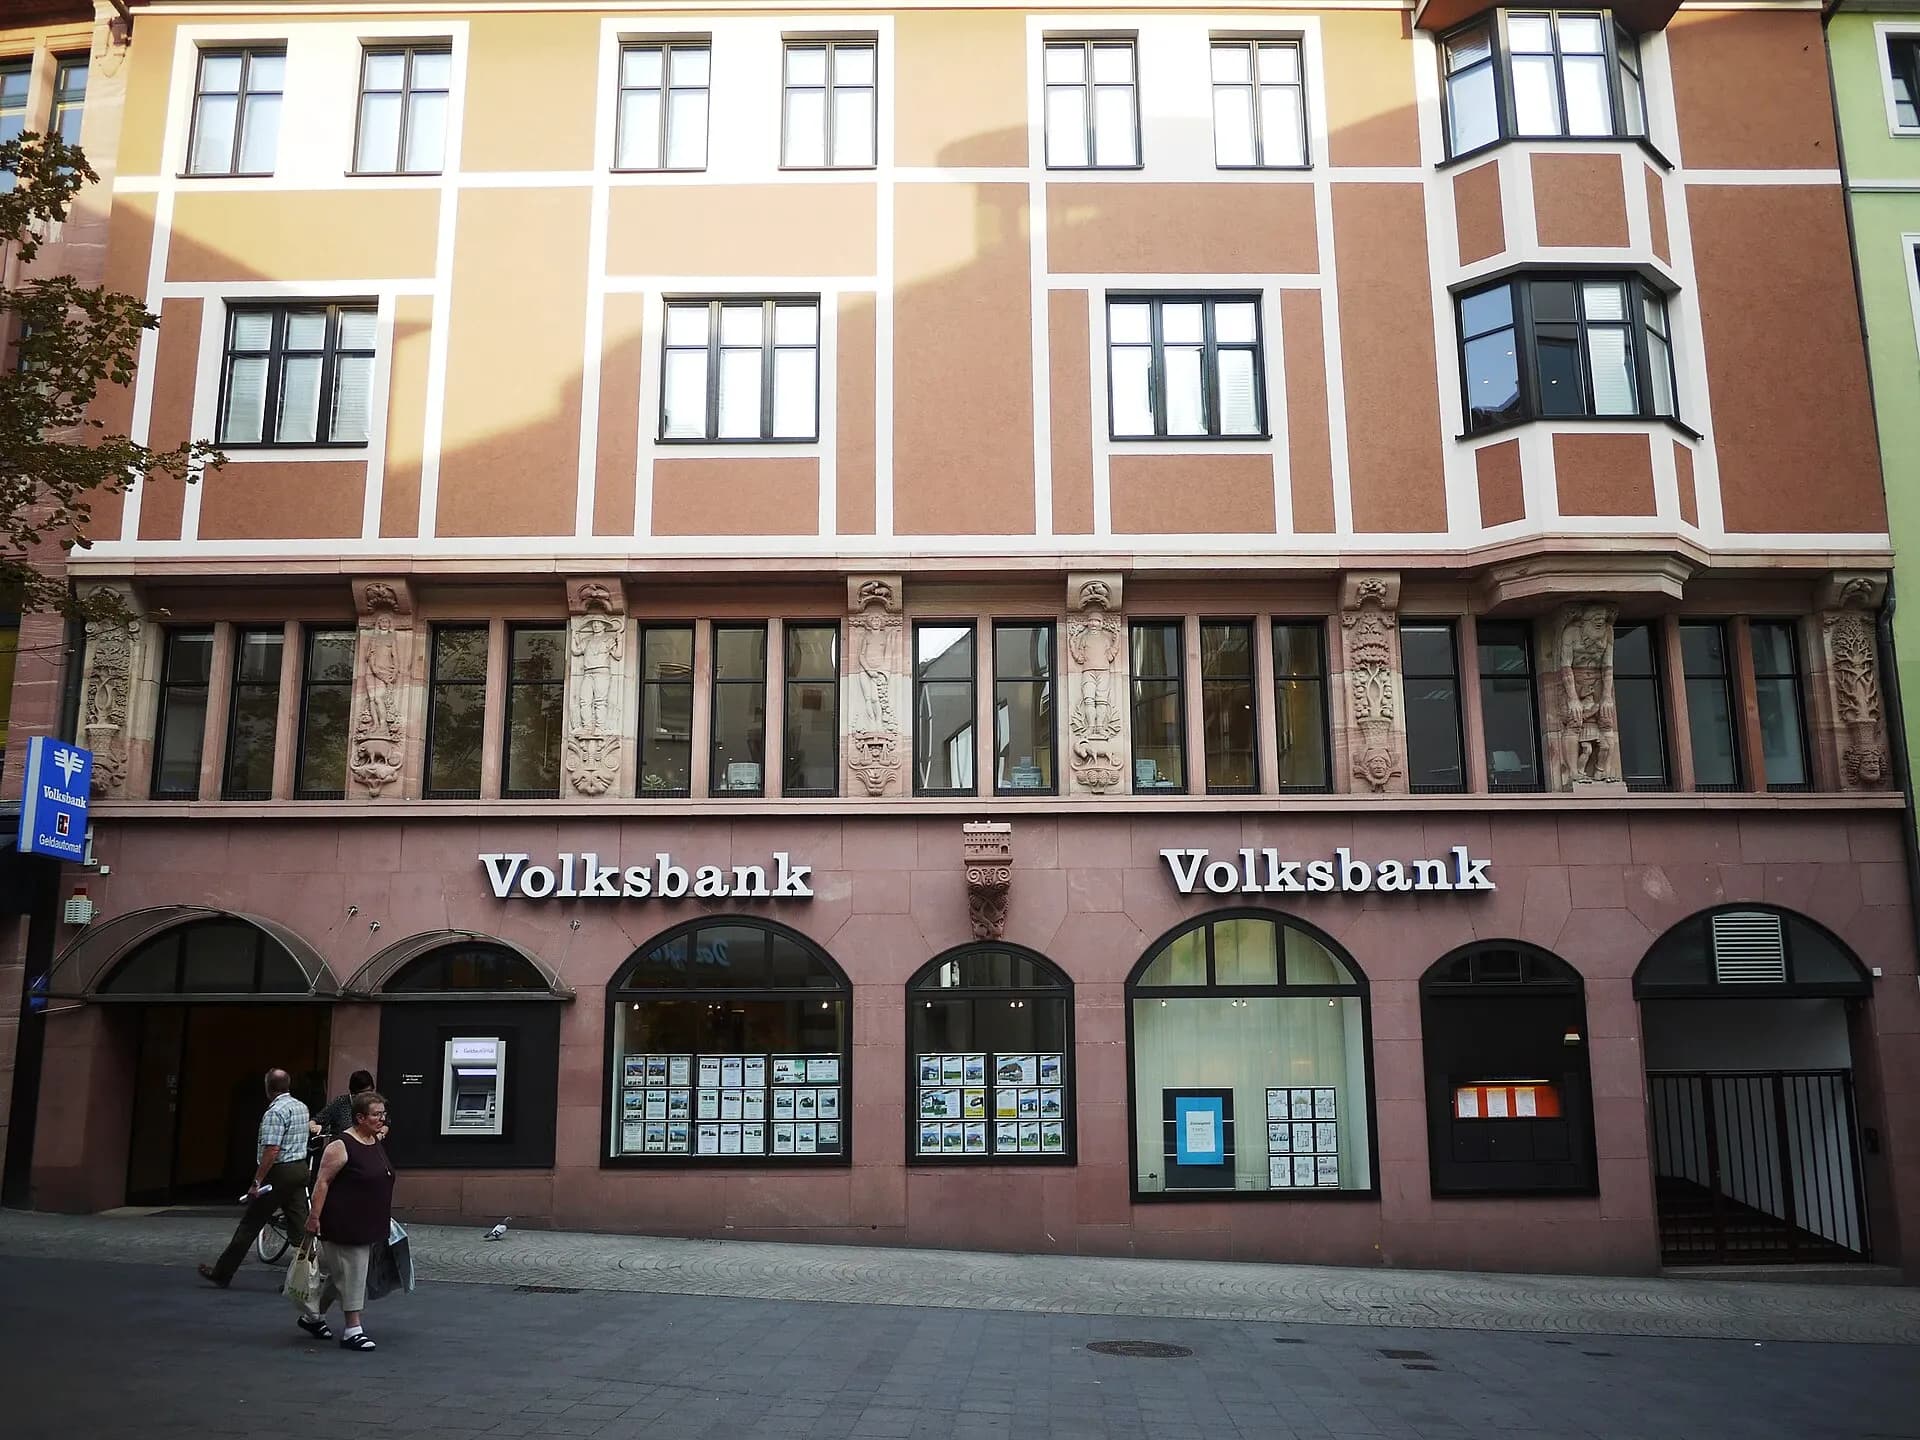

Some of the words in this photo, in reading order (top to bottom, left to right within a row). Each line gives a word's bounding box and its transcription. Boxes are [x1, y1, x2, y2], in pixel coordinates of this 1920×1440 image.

[43, 785, 87, 808] Volksbank
[39, 833, 81, 854] Geldautomat
[478, 851, 814, 898] Volksbank
[1159, 845, 1496, 893] Volksbank
